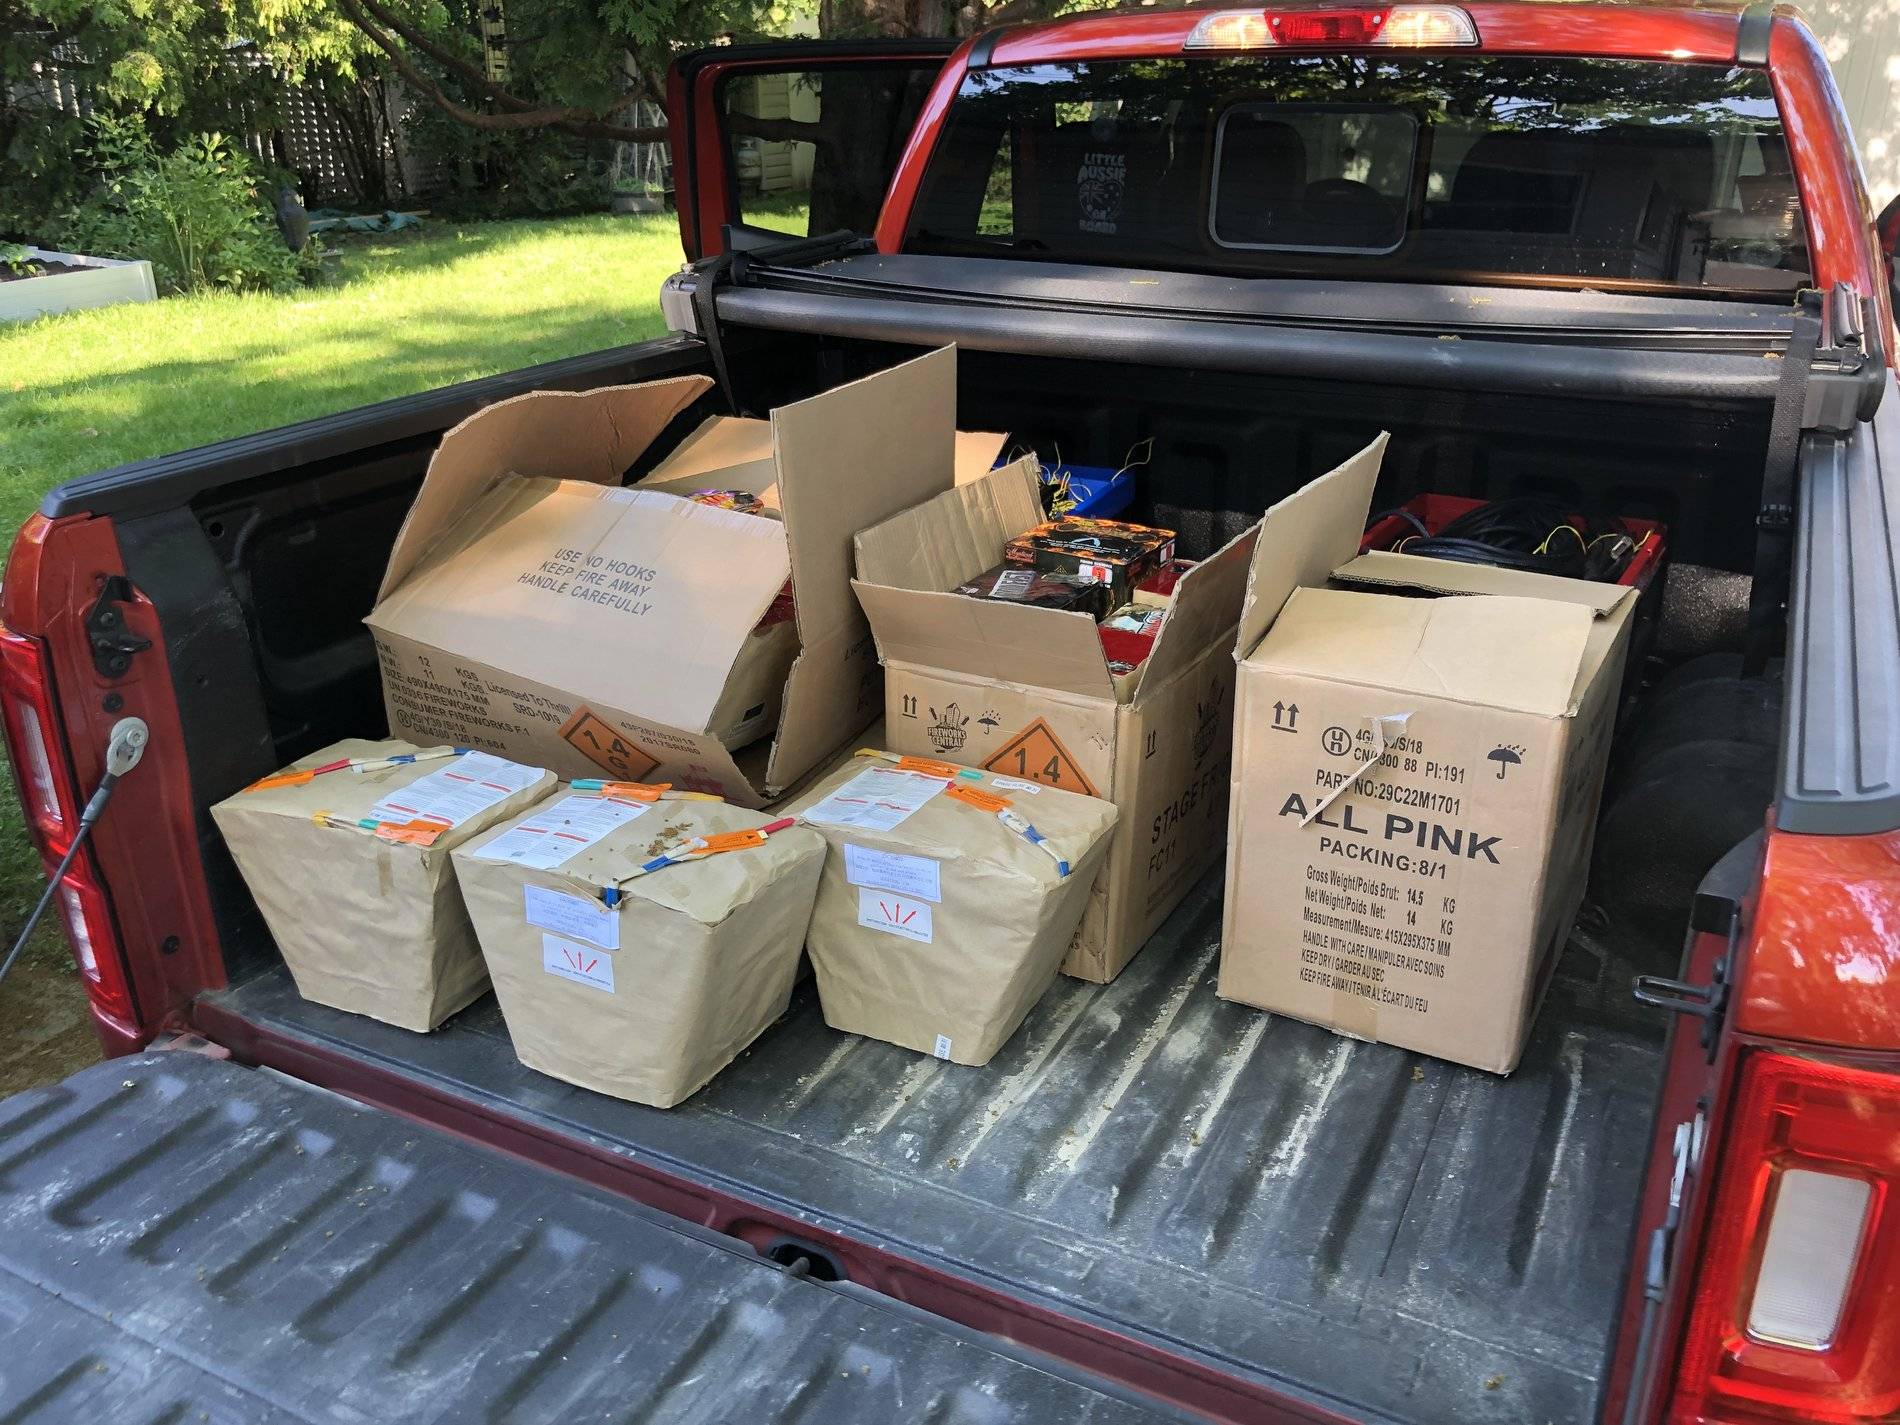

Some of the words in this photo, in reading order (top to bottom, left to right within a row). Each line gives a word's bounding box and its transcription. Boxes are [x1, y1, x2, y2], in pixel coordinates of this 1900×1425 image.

[1077, 165, 1126, 184] AUSSIE
[1085, 153, 1125, 166] LITTLE
[539, 560, 574, 577] KEEP
[575, 570, 607, 586] FIRE
[608, 579, 651, 598] AWAY
[555, 548, 582, 563] USE
[585, 556, 604, 568] NO
[605, 559, 656, 582] HOOKS
[517, 572, 568, 594] HANDLE
[571, 586, 652, 616] CAREFULLY
[418, 656, 431, 667] 12
[424, 669, 435, 681] 11
[392, 693, 447, 718] CONSUMER
[448, 710, 513, 733] FIREWORKS
[423, 692, 487, 717] FIREWORKS
[471, 694, 490, 706] MM
[928, 727, 967, 740] FIREWORKS
[931, 736, 964, 748] CENTRAL
[1015, 748, 1060, 783] 1.4
[1404, 758, 1418, 773] 88
[1426, 761, 1466, 784] PI:191
[1152, 783, 1199, 844] STAGE
[1354, 778, 1461, 816] NO:29C22M1701
[1278, 792, 1369, 835] ALL
[1384, 813, 1503, 865] PINK
[1319, 836, 1447, 880] PACKING:8/1
[1306, 864, 1329, 884] Gross
[1330, 870, 1379, 897] Weight/Poids
[1380, 882, 1400, 901] Brut:
[1407, 887, 1424, 906] 14.5
[1442, 896, 1456, 914] KG
[1305, 886, 1318, 903] Net
[1319, 888, 1367, 915] Weight/Poids
[1370, 902, 1386, 920] Net:
[1407, 910, 1416, 926] 14
[1440, 917, 1454, 935] KG
[1303, 906, 1384, 941] Measurement/Mesure:
[1384, 928, 1435, 953] 415X295X375
[1437, 939, 1451, 957] MM
[1301, 948, 1318, 964] KEEP
[1319, 953, 1331, 968] DRY
[1335, 958, 1361, 977] GARDER
[1361, 965, 1371, 979] AU
[1371, 967, 1385, 983] SEC
[1303, 929, 1328, 949] HANDLE
[1330, 937, 1347, 951] WITH
[1347, 941, 1364, 958] CARE
[1368, 948, 1405, 969] MANIPULER
[1406, 957, 1423, 973] AVEC
[1423, 961, 1445, 979] SOINS
[1300, 968, 1316, 983] KEEP
[1317, 972, 1331, 987] FIRE
[1331, 975, 1350, 993] AWAY
[1352, 981, 1371, 998] TENIR
[1405, 994, 1414, 1009] DU
[1415, 997, 1429, 1013] FEU
